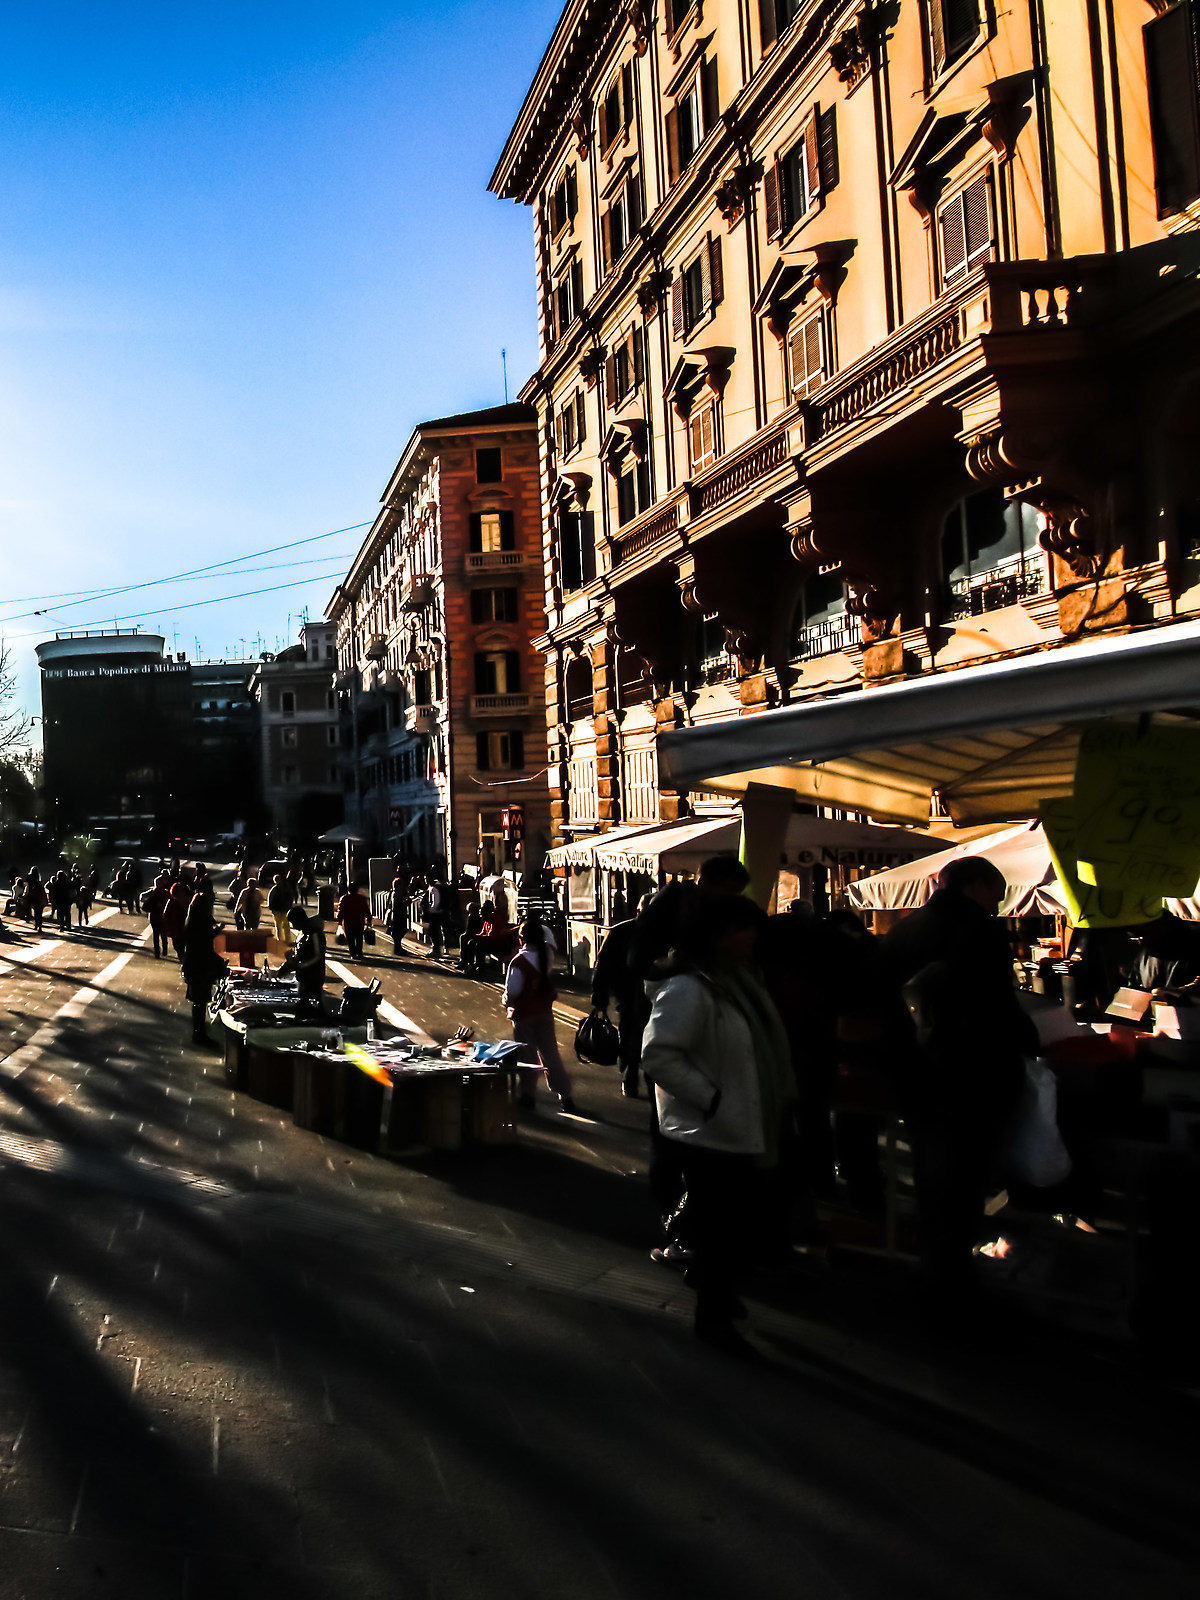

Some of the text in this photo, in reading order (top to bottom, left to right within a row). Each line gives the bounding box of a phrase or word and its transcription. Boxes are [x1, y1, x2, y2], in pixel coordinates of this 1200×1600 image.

[67, 668, 95, 677] Banca
[99, 666, 138, 676] Popolare
[141, 664, 151, 673] di
[154, 663, 187, 673] Milano
[799, 850, 814, 862] e
[822, 847, 914, 863] Natura
